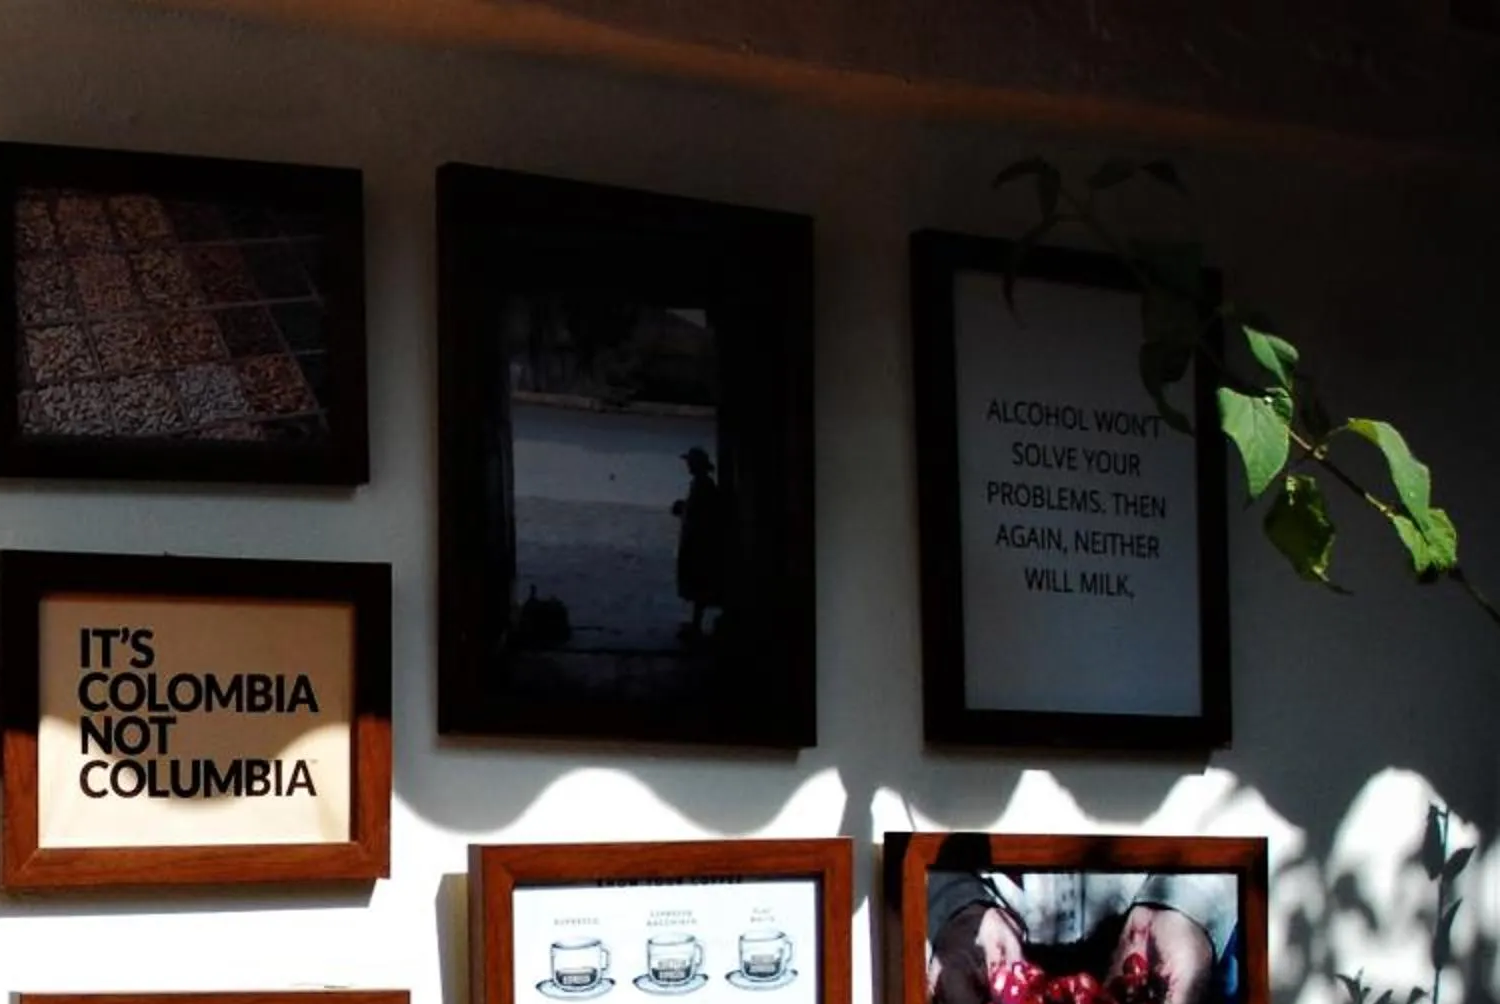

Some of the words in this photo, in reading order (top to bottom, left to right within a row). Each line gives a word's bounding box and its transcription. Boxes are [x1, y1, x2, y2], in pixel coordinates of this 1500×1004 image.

[987, 399, 1090, 432] ALCOHOL
[1093, 408, 1163, 439] WON'T
[1011, 441, 1078, 471] SOLVE
[1082, 448, 1141, 477] YOUR
[986, 480, 1107, 515] PROBLEMS.
[1112, 492, 1167, 519] THEN
[995, 524, 1068, 555] AGAIN,
[1074, 530, 1161, 560] NEITHER
[1023, 567, 1074, 594] WILL
[80, 626, 155, 669] IT'S
[78, 671, 319, 713] COLOMBIA
[80, 715, 177, 755] NOT
[79, 758, 318, 799] COLUMBIA
